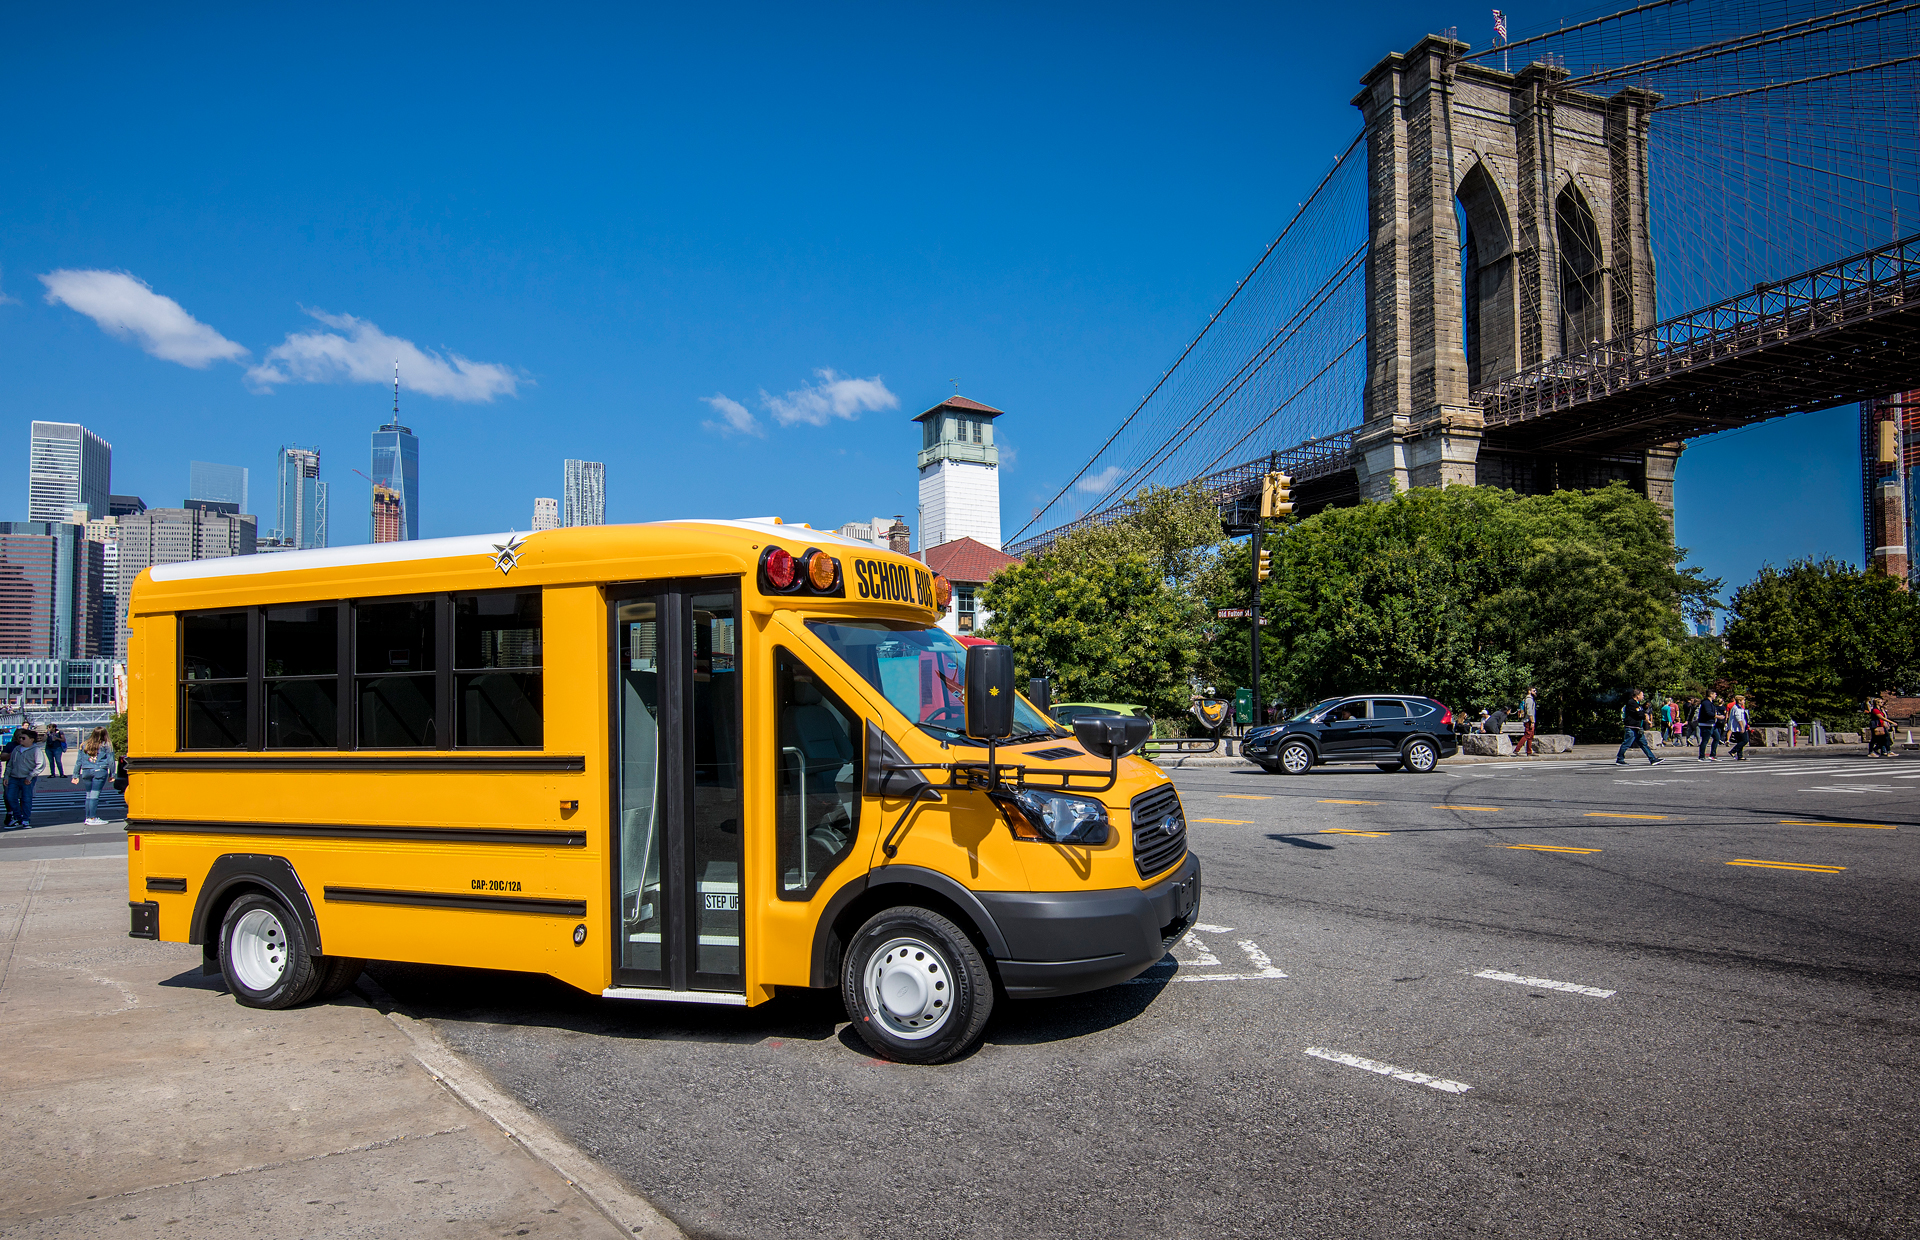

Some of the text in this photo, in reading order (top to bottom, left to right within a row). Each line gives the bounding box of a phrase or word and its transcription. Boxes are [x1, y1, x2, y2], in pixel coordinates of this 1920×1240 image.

[855, 559, 933, 608] SCHOOL BUS
[1218, 610, 1227, 618] Old
[471, 879, 522, 892] CAP: 20C/12A
[706, 894, 727, 909] STEP
